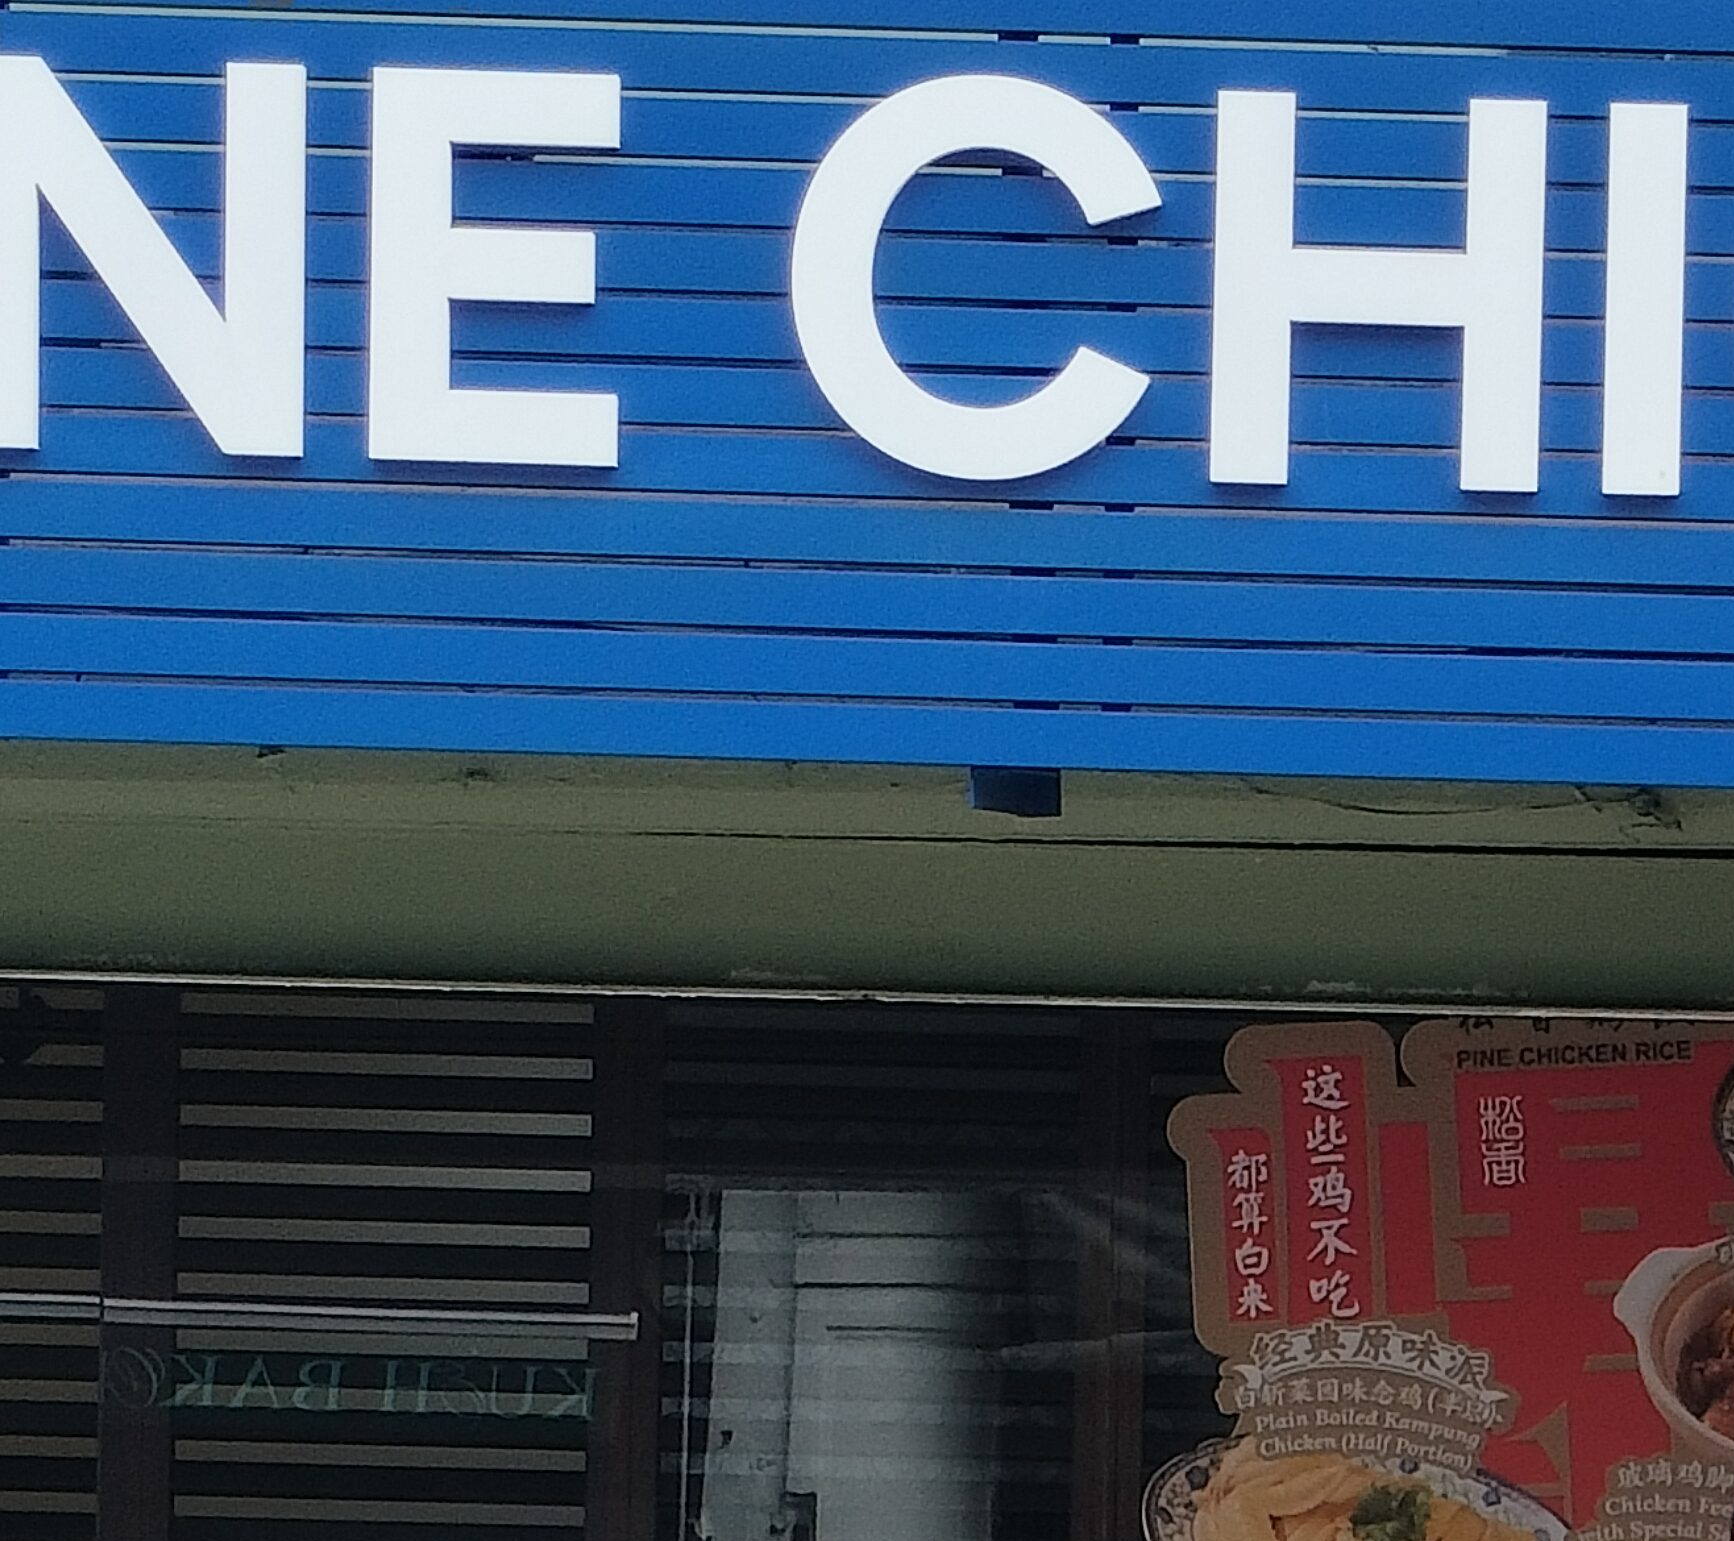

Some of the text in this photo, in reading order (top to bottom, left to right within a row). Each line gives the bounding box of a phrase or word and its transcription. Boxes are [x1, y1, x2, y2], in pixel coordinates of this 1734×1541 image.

[1457, 1040, 1692, 1069] PINE CHICKEN RICE
[1302, 1065, 1360, 1317] 这些鸡不吃
[1227, 1149, 1273, 1319] 都算白来
[1253, 1324, 1487, 1390] 经典原味派
[1256, 1410, 1481, 1450] Plain Boiled Kampung
[1261, 1433, 1473, 1472] Chicken (Half Portion)
[1605, 1494, 1733, 1518] Chicken Fee
